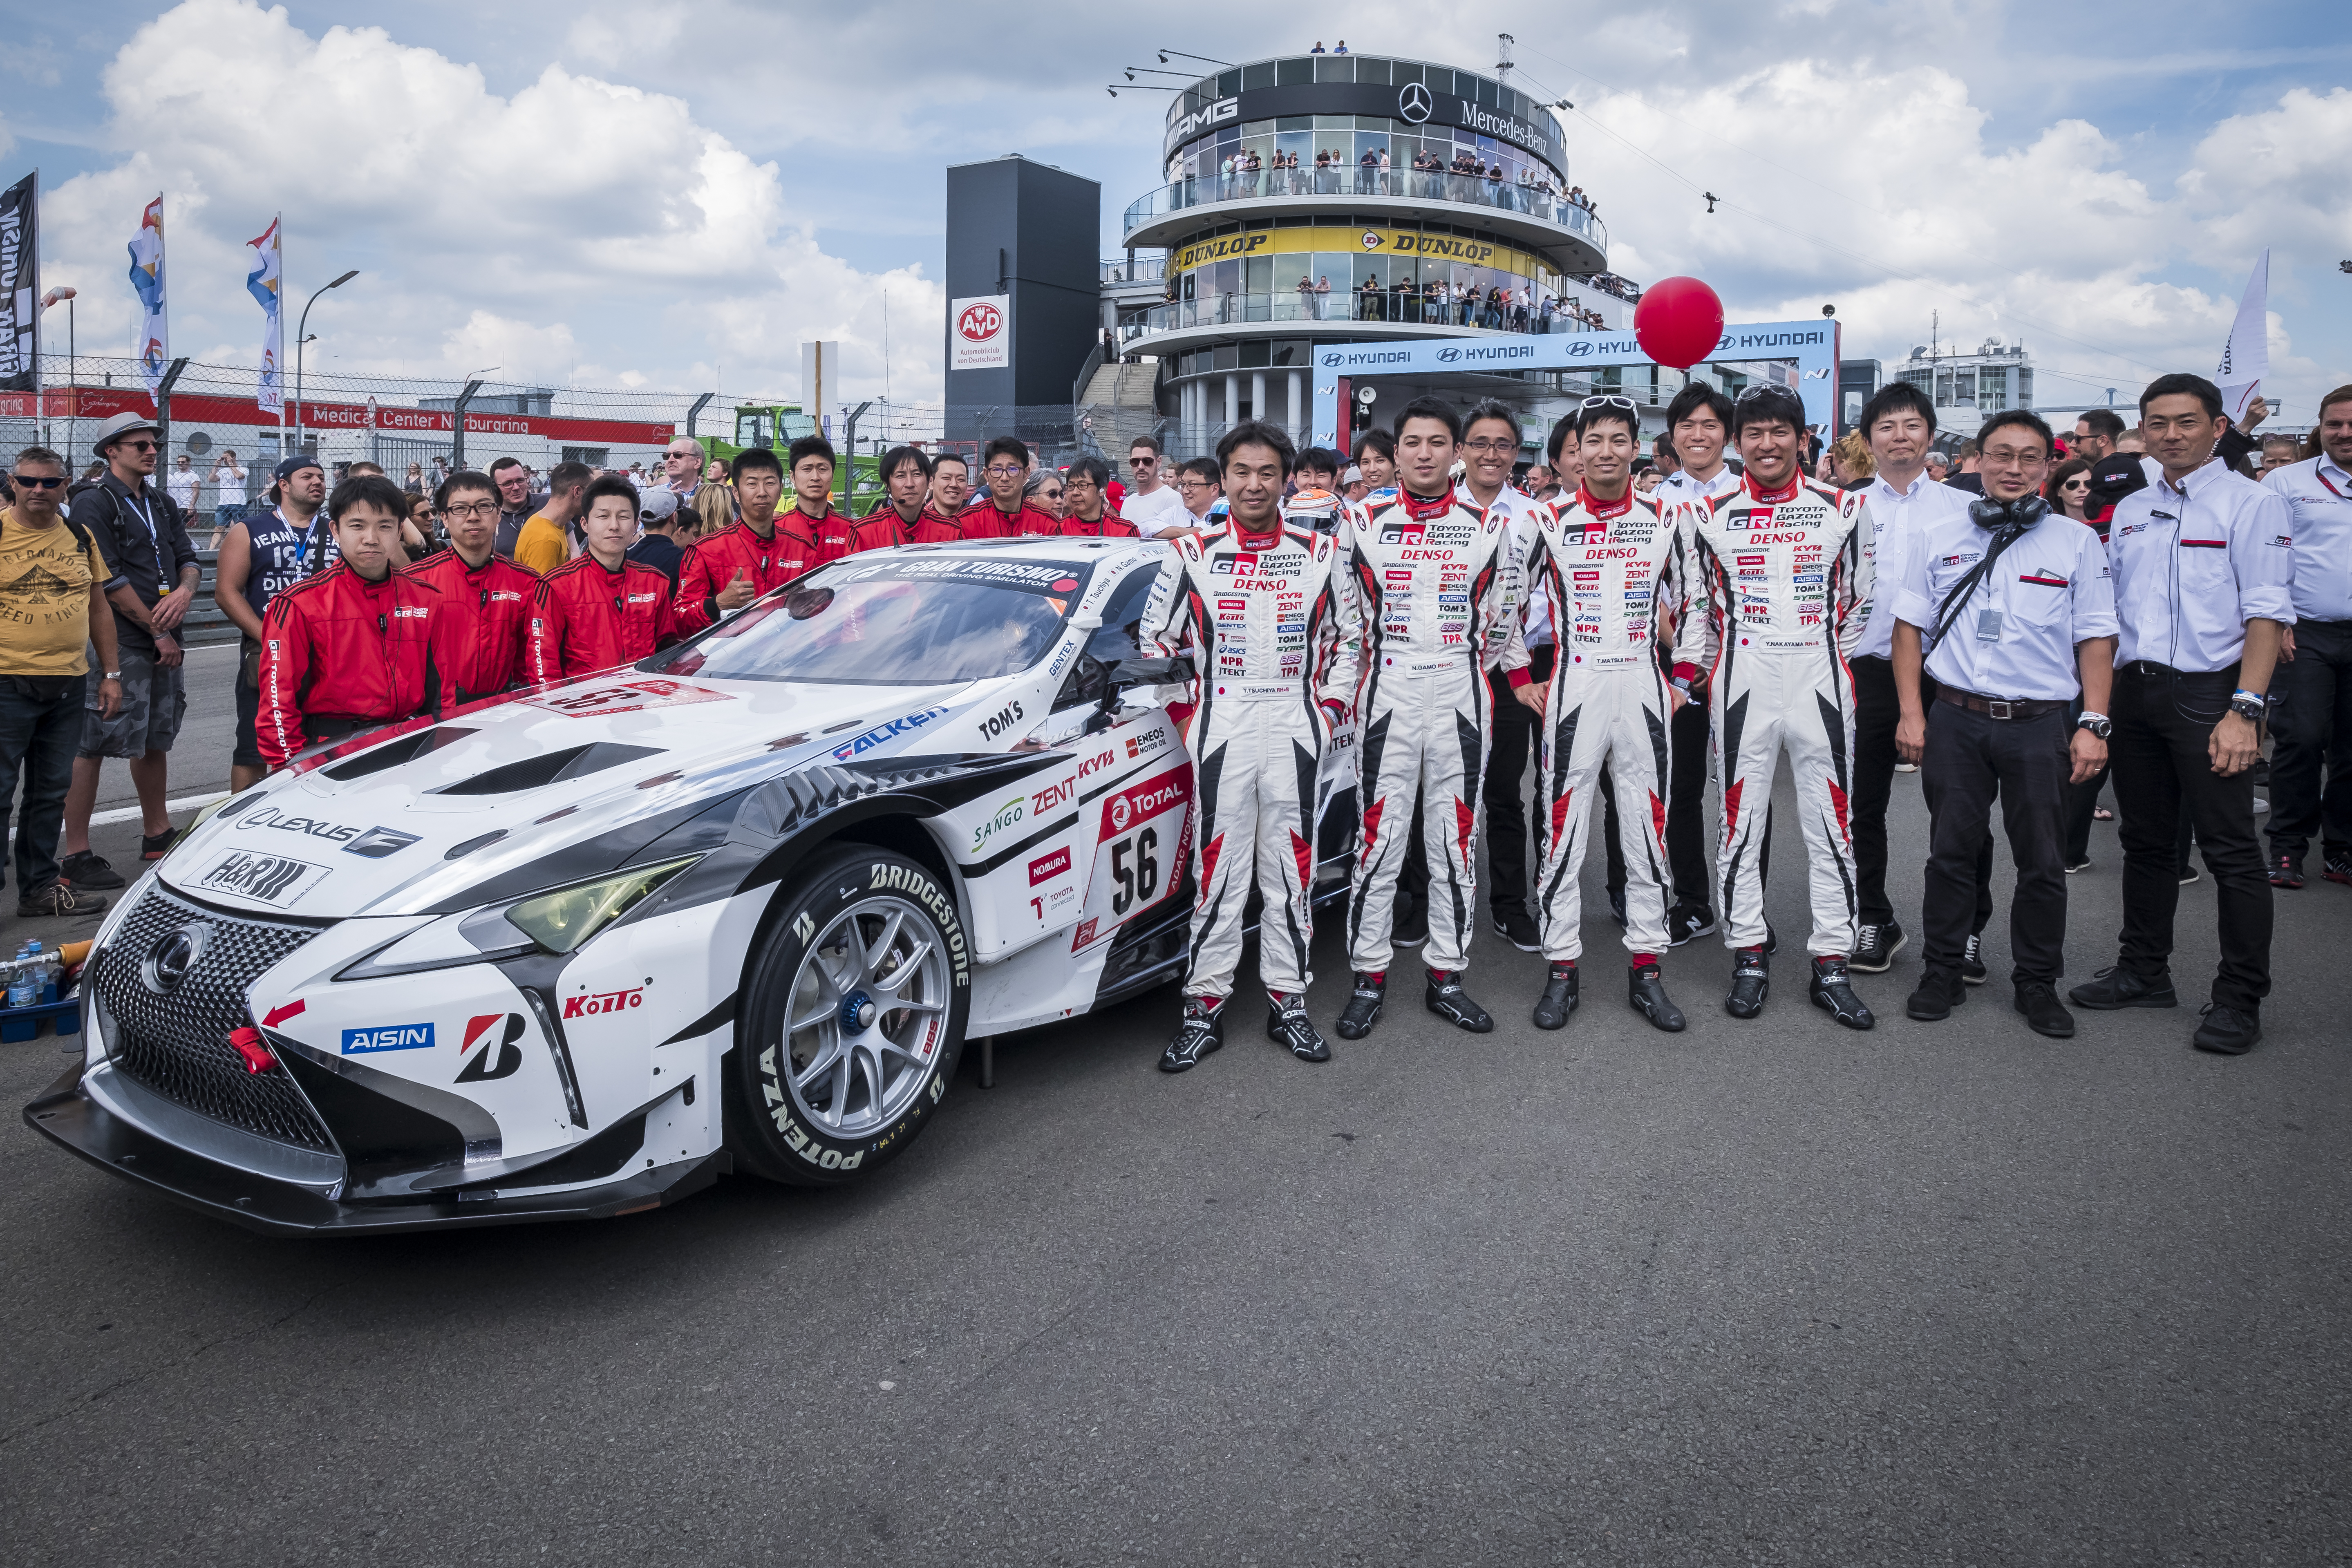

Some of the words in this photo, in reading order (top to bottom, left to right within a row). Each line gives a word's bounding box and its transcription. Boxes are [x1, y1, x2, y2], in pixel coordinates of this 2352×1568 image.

[1176, 97, 1237, 142] AMG
[1461, 101, 1546, 156] Mercedes-Benz
[1184, 235, 1267, 266] DUNLOP
[1393, 235, 1493, 261] DUNLOP
[1741, 332, 1823, 347] HYUNDAI
[960, 347, 999, 355] Automobilclub
[1466, 346, 1533, 359] HYUNDAI
[1349, 352, 1410, 364] HYUNDAI
[314, 407, 369, 424] Medica
[383, 411, 434, 427] Center
[441, 417, 528, 434] Nrburgring
[1728, 516, 1771, 529] GR
[1775, 520, 1821, 529] Racing
[1381, 532, 1422, 544] GR
[1564, 531, 1605, 545] GR
[1750, 532, 1805, 544] DENSO
[1401, 550, 1453, 560] DENSO
[1586, 548, 1637, 560] DENSO
[1794, 554, 1822, 562] ZENT
[900, 561, 960, 573] GRAN
[965, 561, 1068, 581] TURISMO
[1212, 560, 1254, 575] GR
[985, 575, 1047, 587] SIMULATOR
[1233, 579, 1286, 591] DENSO
[1278, 602, 1303, 611] ZENT
[1744, 605, 1767, 614] NPR
[1798, 604, 1822, 613] BBS
[1627, 620, 1647, 630] BBS
[1742, 616, 1771, 624] JTEKT
[1799, 615, 1821, 625] TPR
[1386, 625, 1408, 634] NPR
[1441, 623, 1464, 632] BBS
[1577, 624, 1599, 634] NPR
[1278, 635, 1304, 643] TOM'S
[1386, 634, 1410, 642] JTEKT
[1442, 634, 1463, 644] TPR
[1575, 634, 1602, 644] JTEKT
[1628, 632, 1646, 642] TPR
[535, 638, 543, 676] TOYOTA
[1049, 640, 1074, 676] GENTEX
[1054, 646, 1077, 681] CORPORATION
[1221, 656, 1243, 667] NPR
[1280, 654, 1302, 665] BBS
[1218, 667, 1246, 676] JTEKT
[1281, 667, 1298, 677] TPR
[576, 708, 624, 717] ADAC
[978, 700, 1023, 742] TOM'S
[273, 710, 286, 747] GAZOO
[832, 706, 949, 761] FALKEN
[1137, 727, 1164, 746] ENEOS
[1140, 743, 1157, 754] MOTOR
[1158, 738, 1166, 748] OIL
[1079, 749, 1114, 779] KYB
[1032, 775, 1076, 816] ZENT
[1132, 783, 1183, 814] TOTAL
[267, 817, 361, 841] LEXUS
[975, 807, 1022, 843] SANGO
[1033, 856, 1066, 878] NOMURA
[1111, 826, 1158, 916] 56
[1171, 849, 1185, 890] ADAC
[1050, 886, 1074, 902] TOYOTA
[1050, 894, 1074, 910] connected
[868, 863, 969, 987] BRIDGESTONE
[349, 1028, 427, 1049] AISIN
[923, 1020, 938, 1055] BBS
[760, 1044, 864, 1170] POTENZA
